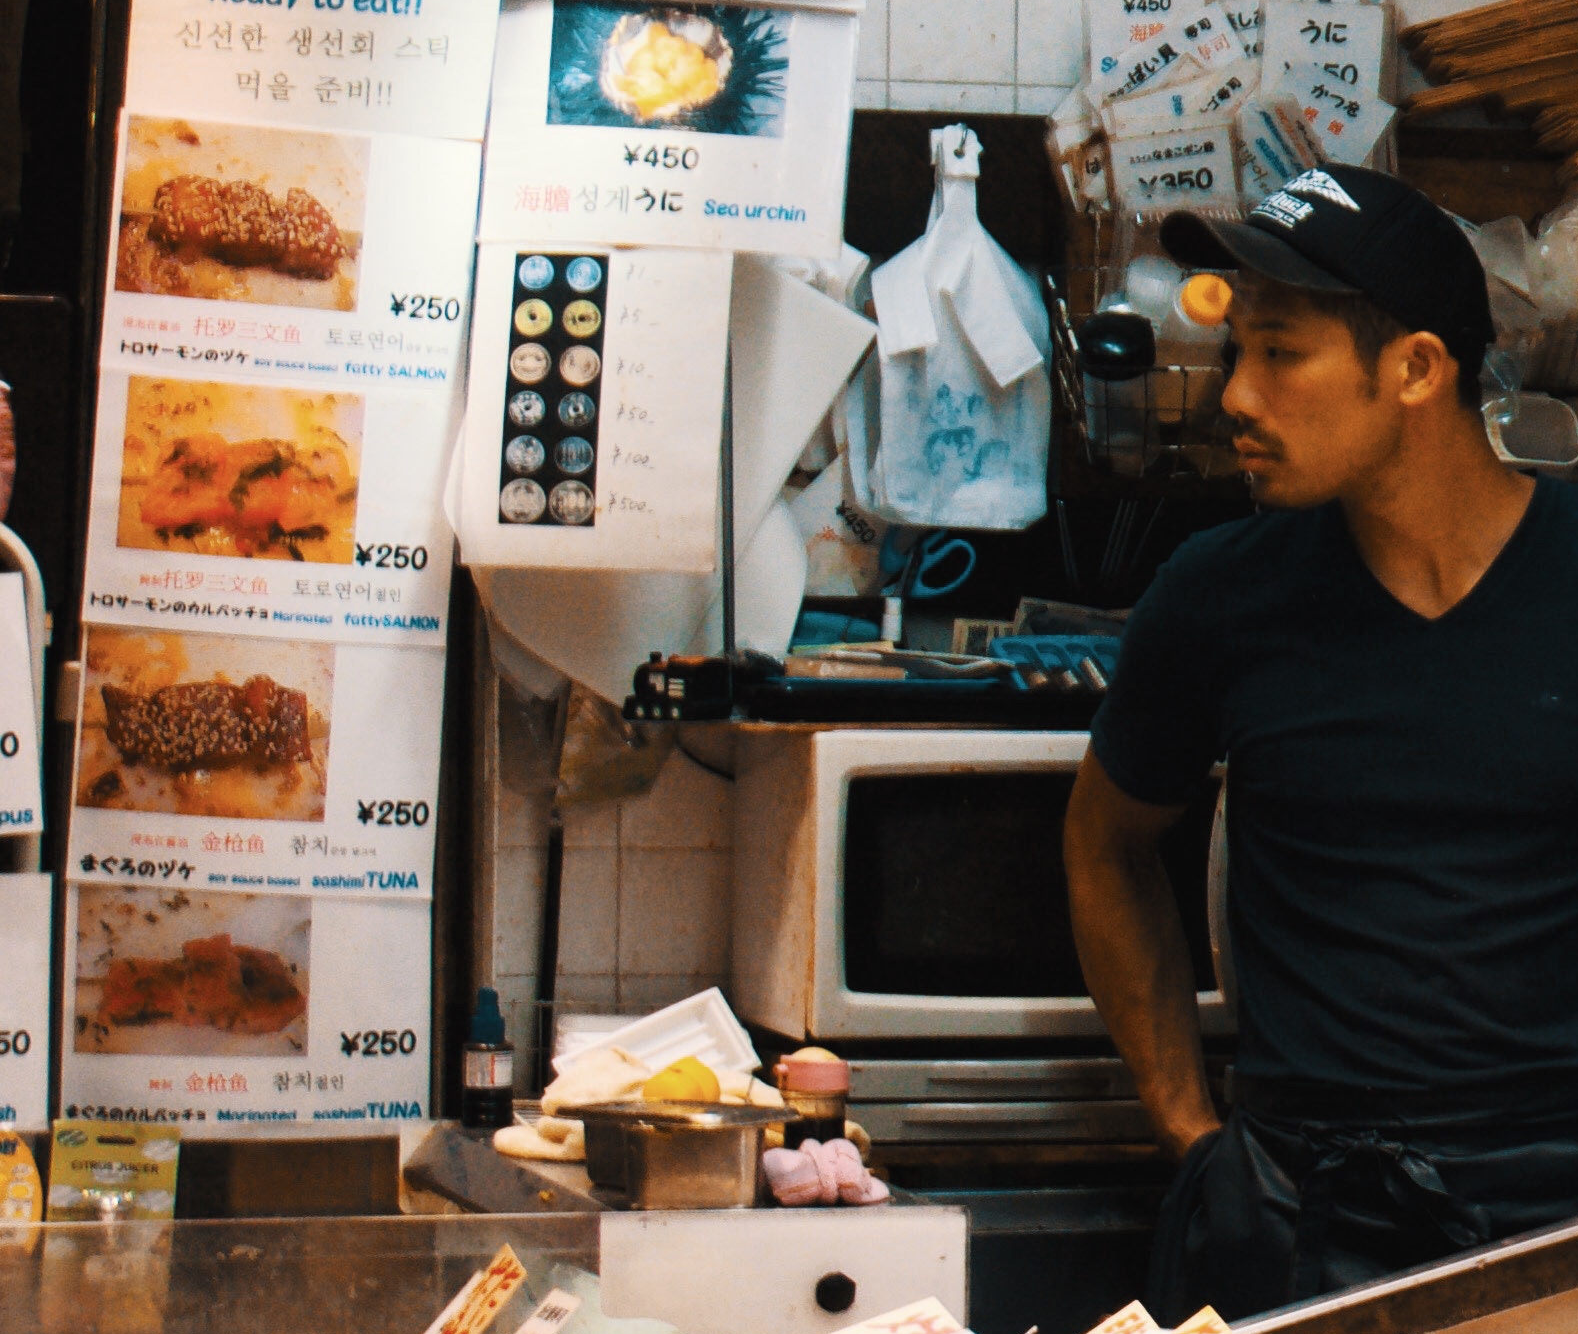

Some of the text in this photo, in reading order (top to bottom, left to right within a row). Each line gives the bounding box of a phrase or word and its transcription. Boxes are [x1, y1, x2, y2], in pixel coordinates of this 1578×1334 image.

[174, 20, 268, 52] 신선한
[287, 25, 375, 61] 생선회
[1299, 19, 1347, 44] うに
[236, 68, 296, 101] 먹을
[622, 145, 700, 170] ¥450
[635, 188, 685, 212] うに
[703, 199, 740, 216] Sea
[744, 203, 806, 223] urchin
[390, 291, 461, 322] ¥250
[387, 363, 447, 381] SALMON
[355, 542, 428, 571] ¥250
[356, 798, 430, 829] ¥250
[79, 851, 196, 881] まぐろのヅケ
[340, 1029, 417, 1057] ¥250
